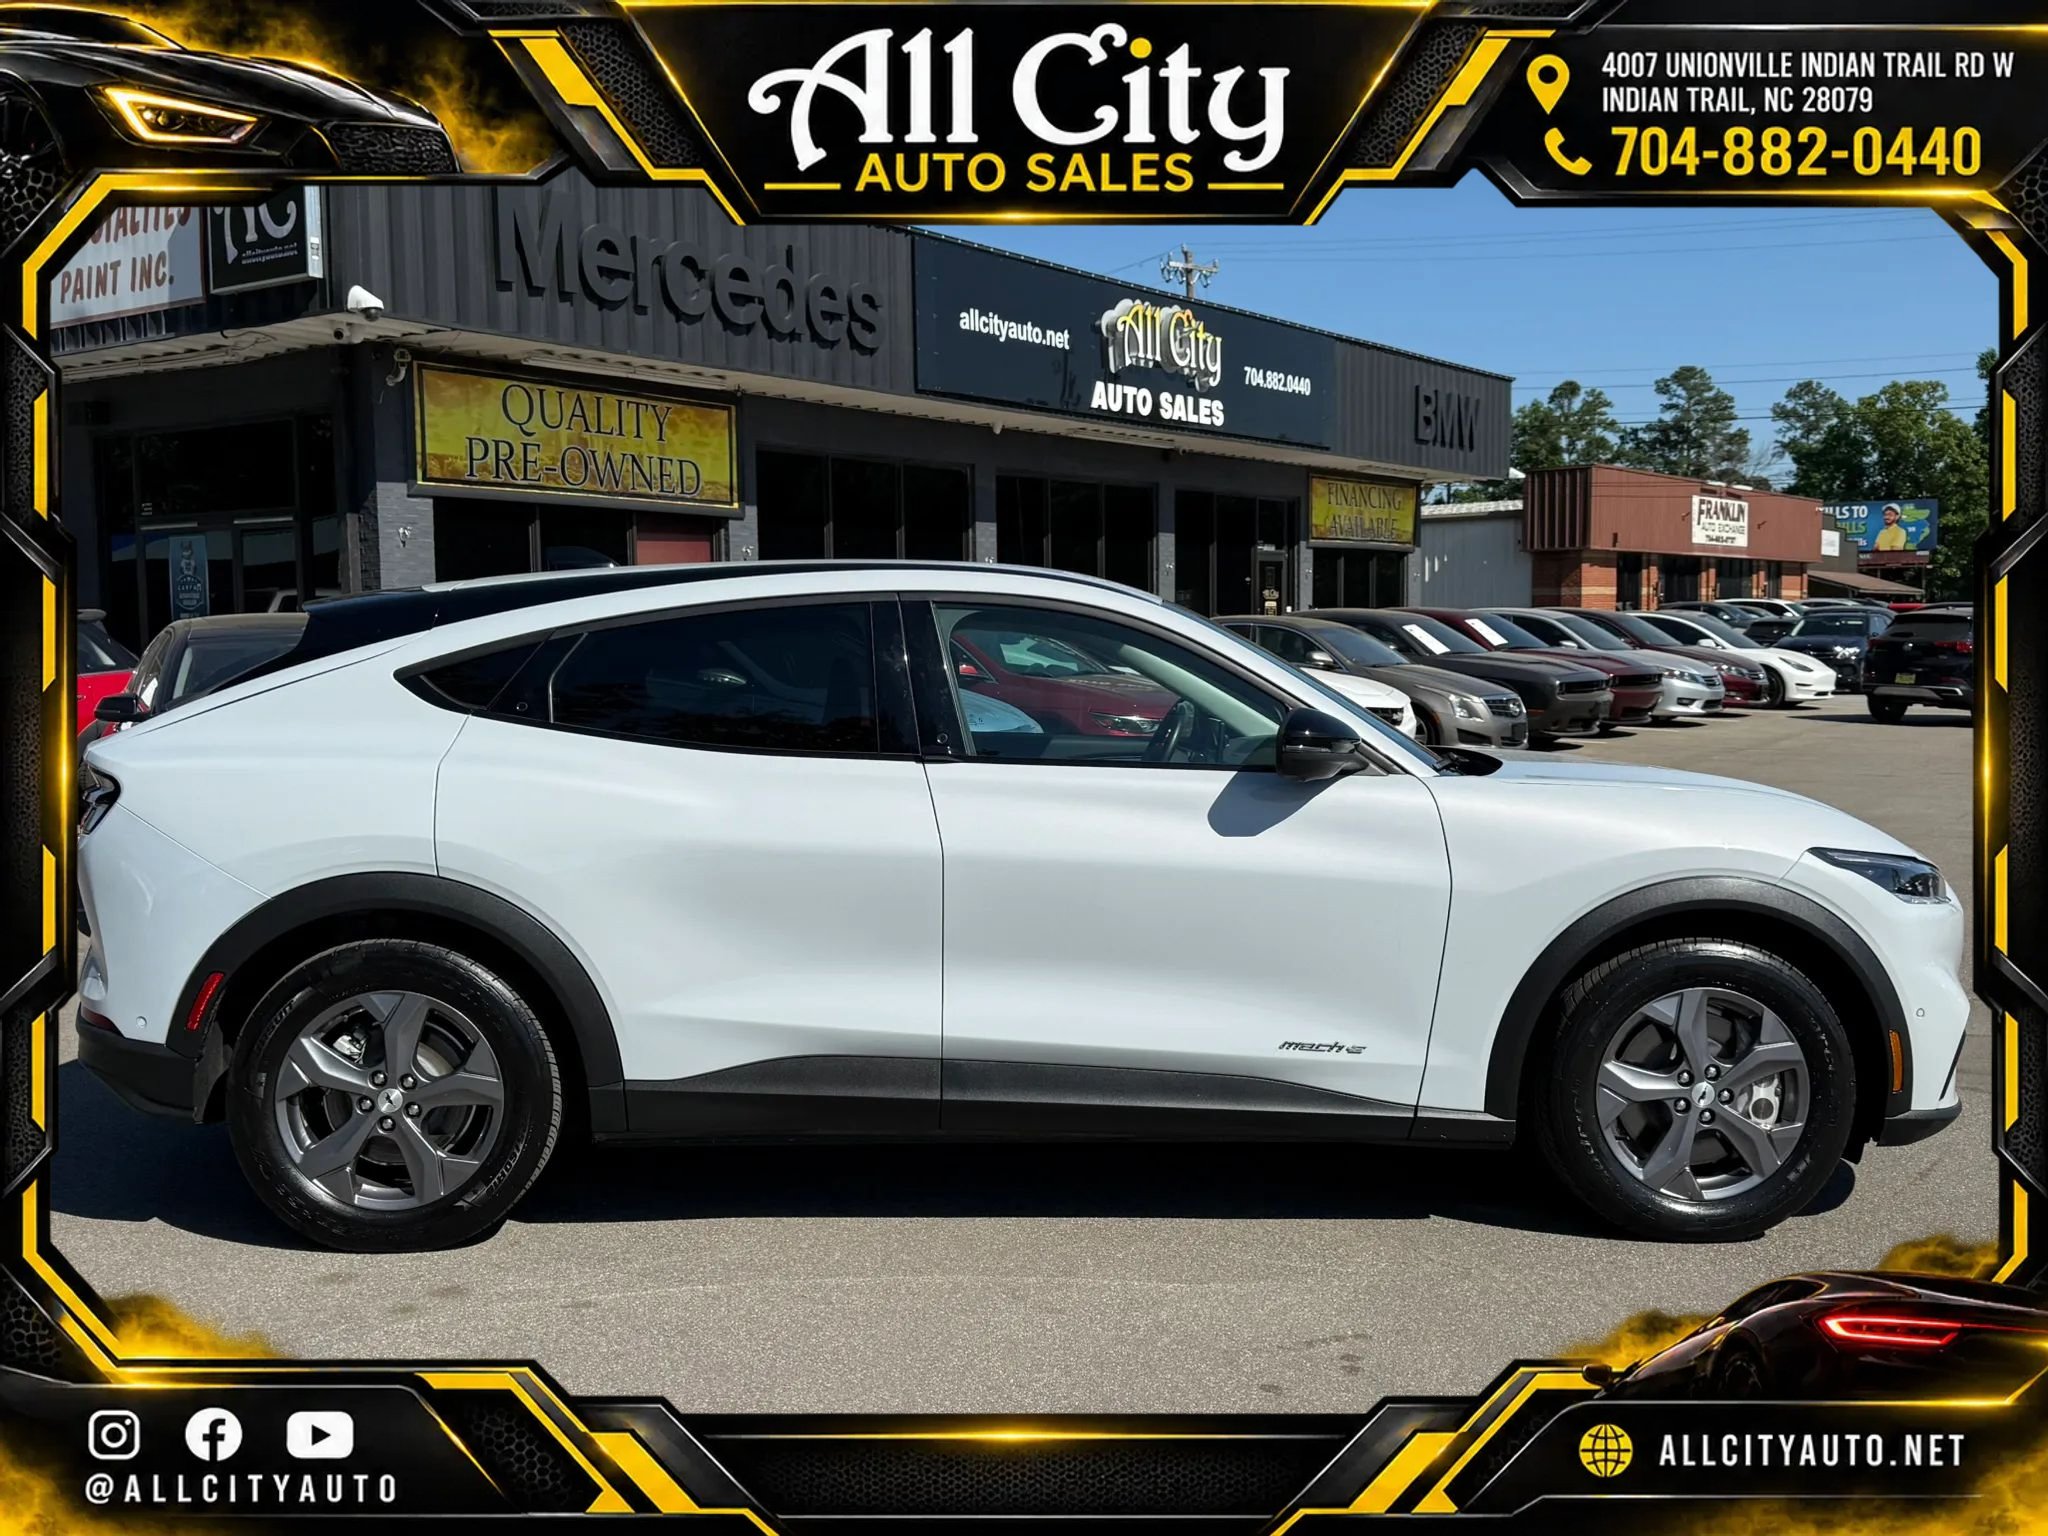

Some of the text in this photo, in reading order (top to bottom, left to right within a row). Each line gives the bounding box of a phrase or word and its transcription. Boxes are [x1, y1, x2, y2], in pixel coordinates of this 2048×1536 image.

[60, 250, 175, 304] PAINT INC.
[496, 186, 885, 354] Mercedes
[959, 307, 1070, 351] allcityauto.net
[1110, 300, 1223, 388] All City
[1090, 380, 1225, 427] AUTO SALES
[1244, 366, 1311, 396] 704.882.0440
[501, 384, 673, 443] QUALITY
[1413, 384, 1481, 453] BMW
[465, 436, 702, 496] PRE-OWNED
[1327, 482, 1402, 511] FINANCING
[1697, 498, 1746, 526] FRANKLIN
[1851, 505, 1868, 518] TO
[1328, 513, 1399, 540] AVAILABLE
